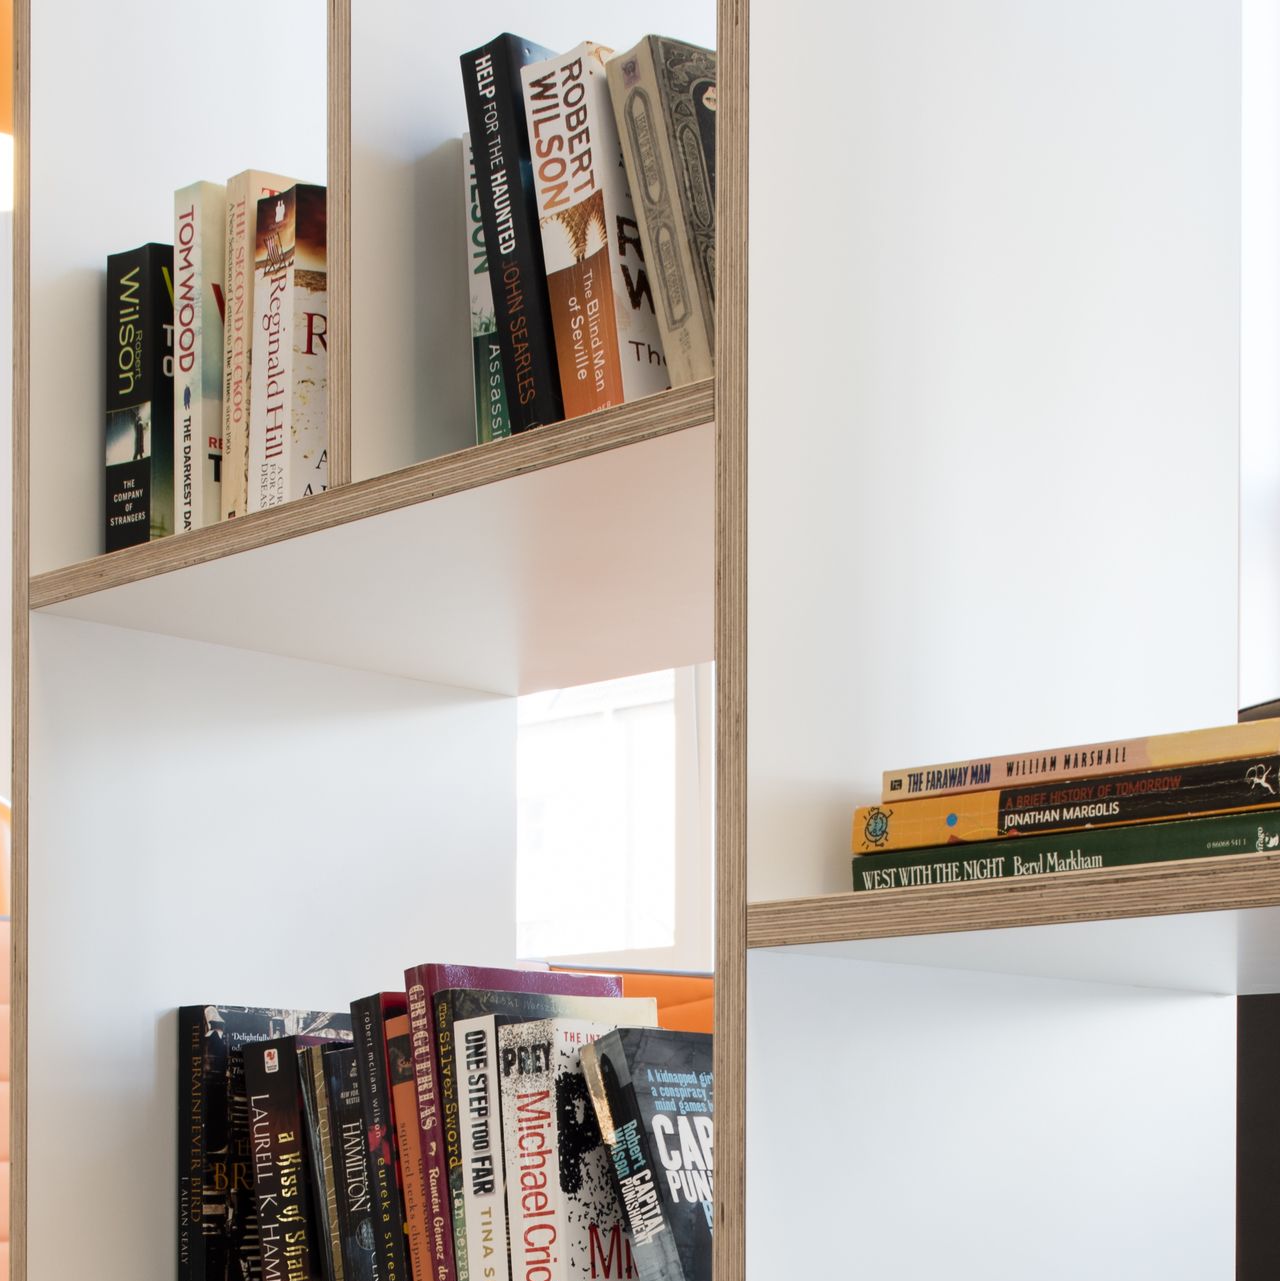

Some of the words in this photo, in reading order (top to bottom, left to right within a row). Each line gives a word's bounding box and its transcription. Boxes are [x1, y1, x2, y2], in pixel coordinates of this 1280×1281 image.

[475, 54, 496, 98] HELP
[483, 101, 499, 135] FOR
[560, 57, 595, 193] ROBERT
[488, 137, 504, 170] THE
[529, 71, 571, 210] WILSON
[235, 196, 246, 239] THE
[491, 170, 516, 255] HAUNTED
[179, 204, 194, 271] TOM
[234, 246, 245, 334] SECOND
[582, 268, 594, 299] The
[179, 272, 195, 373] WOOD
[262, 272, 287, 398] Reginald
[585, 299, 601, 350] Blind
[134, 329, 143, 380] Robert
[591, 352, 606, 392] Man
[232, 340, 243, 423] CUCKOO
[183, 416, 192, 443] THE
[265, 404, 284, 460] Hill
[113, 487, 144, 503] COMPANY
[123, 479, 135, 489] THE
[183, 445, 192, 508] DARKEST
[110, 511, 146, 526] STRANGERS
[125, 502, 133, 512] OF
[1006, 796, 1013, 808] A
[1016, 793, 1046, 808] BRIEF
[1050, 786, 1093, 804] HISTORY
[1098, 784, 1111, 798] OF
[1116, 775, 1181, 795] TOMORROW
[1004, 808, 1060, 829] JONATHAN
[1063, 802, 1120, 820] MARGOLIS
[862, 868, 896, 891] WEST
[899, 864, 932, 887] WITH
[934, 861, 962, 883] THE
[963, 857, 1005, 880] NIGHT
[363, 1011, 373, 1047] robert
[438, 1002, 447, 1026] The
[438, 1030, 453, 1096] Silver
[464, 1030, 486, 1070] ONE
[368, 1051, 378, 1094] mcliam
[468, 1071, 489, 1118] STEP
[372, 1098, 382, 1138] wilson
[655, 1100, 677, 1112] mind
[679, 1101, 706, 1114] games
[250, 1094, 273, 1184] LAURELL
[444, 1104, 462, 1169] Sword
[471, 1116, 489, 1151] TOO
[516, 1090, 556, 1218] Michael
[623, 1119, 646, 1169] Robert
[342, 1121, 367, 1212] HAMILTON
[400, 1122, 414, 1177] squirrel
[407, 1182, 417, 1220] seeks
[472, 1153, 494, 1196] FAR
[259, 1193, 278, 1217] K.
[377, 1157, 391, 1222] eureka
[428, 1167, 441, 1213] Ramón
[452, 1189, 464, 1222] Ian
[432, 1216, 444, 1260] Gómez
[480, 1207, 495, 1259] TINA
[437, 1265, 446, 1281] de
